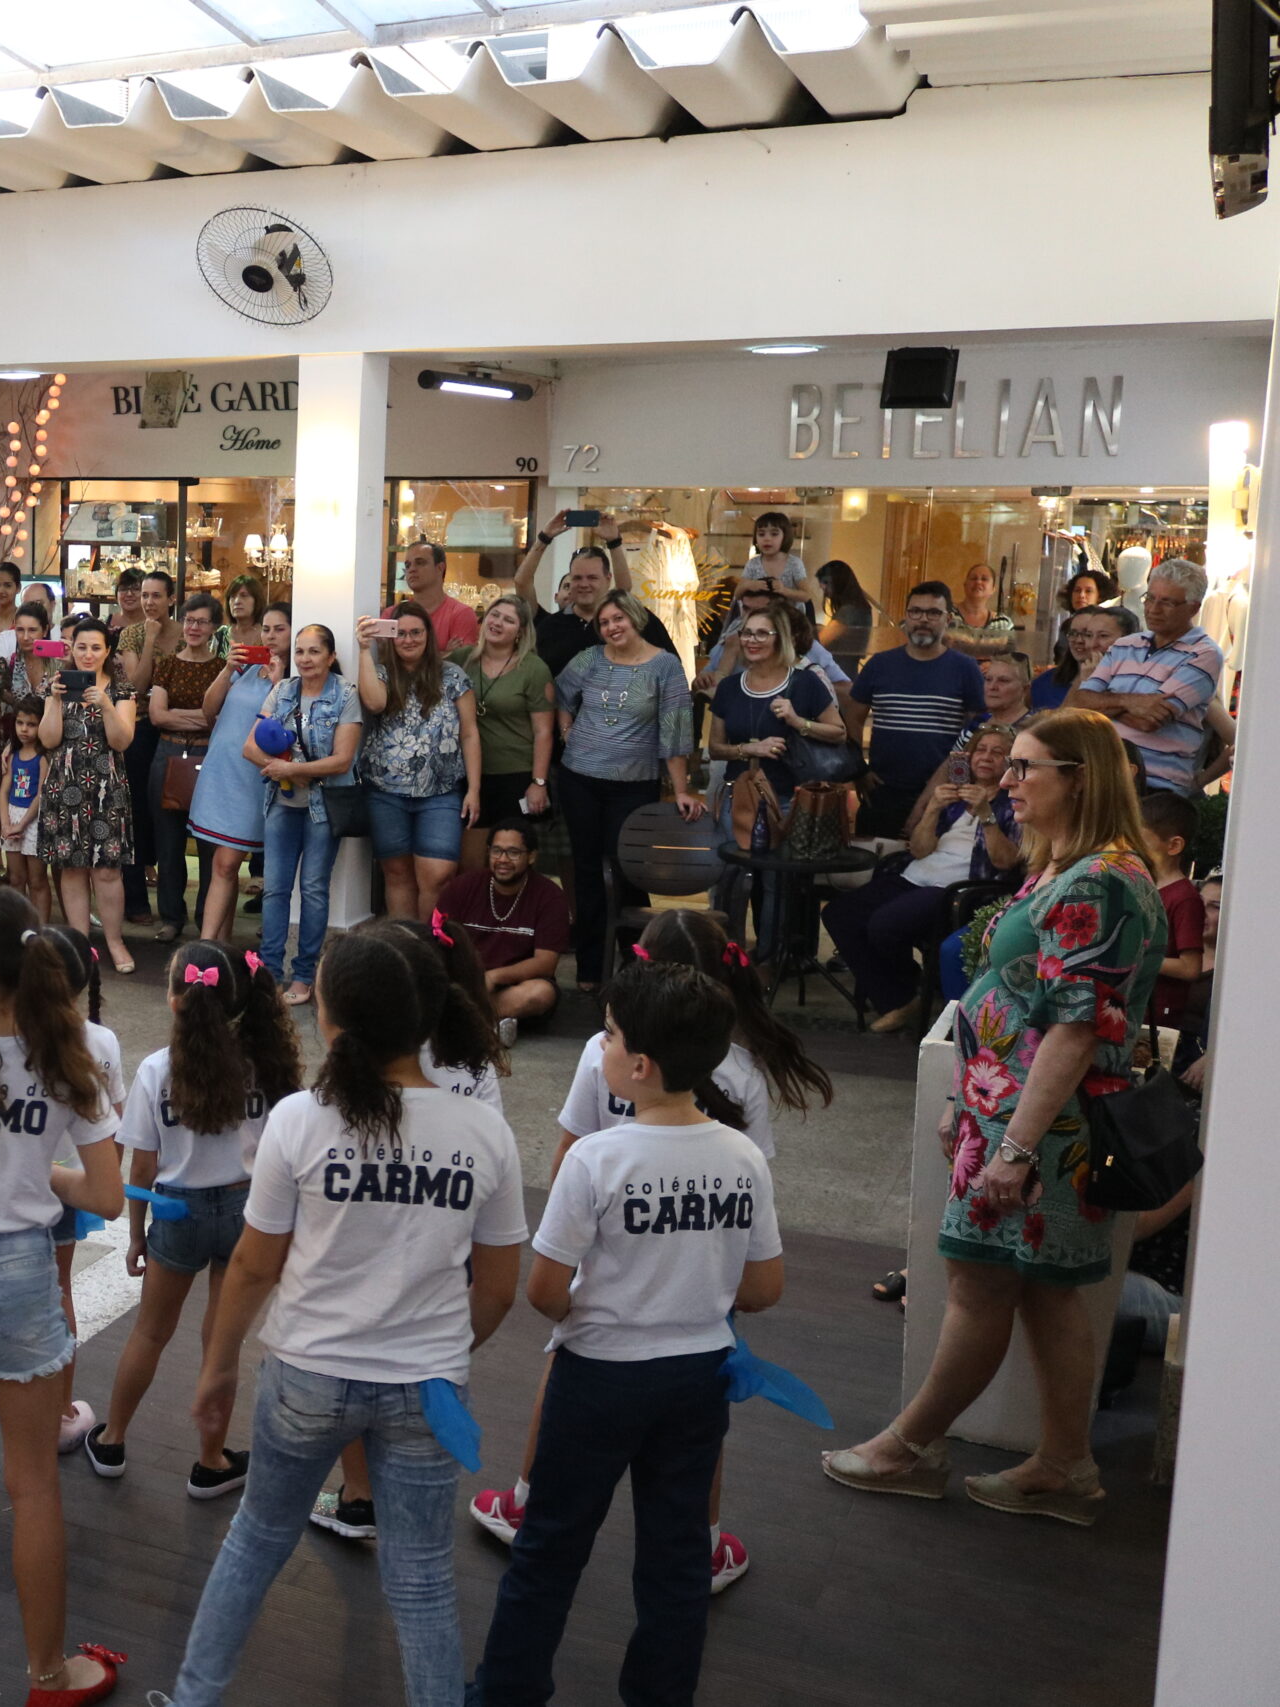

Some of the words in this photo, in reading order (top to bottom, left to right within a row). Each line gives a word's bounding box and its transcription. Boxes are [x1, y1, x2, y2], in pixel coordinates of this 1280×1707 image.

[220, 425, 282, 451] Home
[515, 457, 538, 473] 90
[563, 444, 600, 473] 72
[640, 579, 720, 601] Summer
[451, 1150, 475, 1169] do
[324, 1163, 475, 1211] CARMO
[625, 1175, 722, 1196] colégio
[736, 1174, 753, 1190] do
[623, 1192, 754, 1235] CARMO
